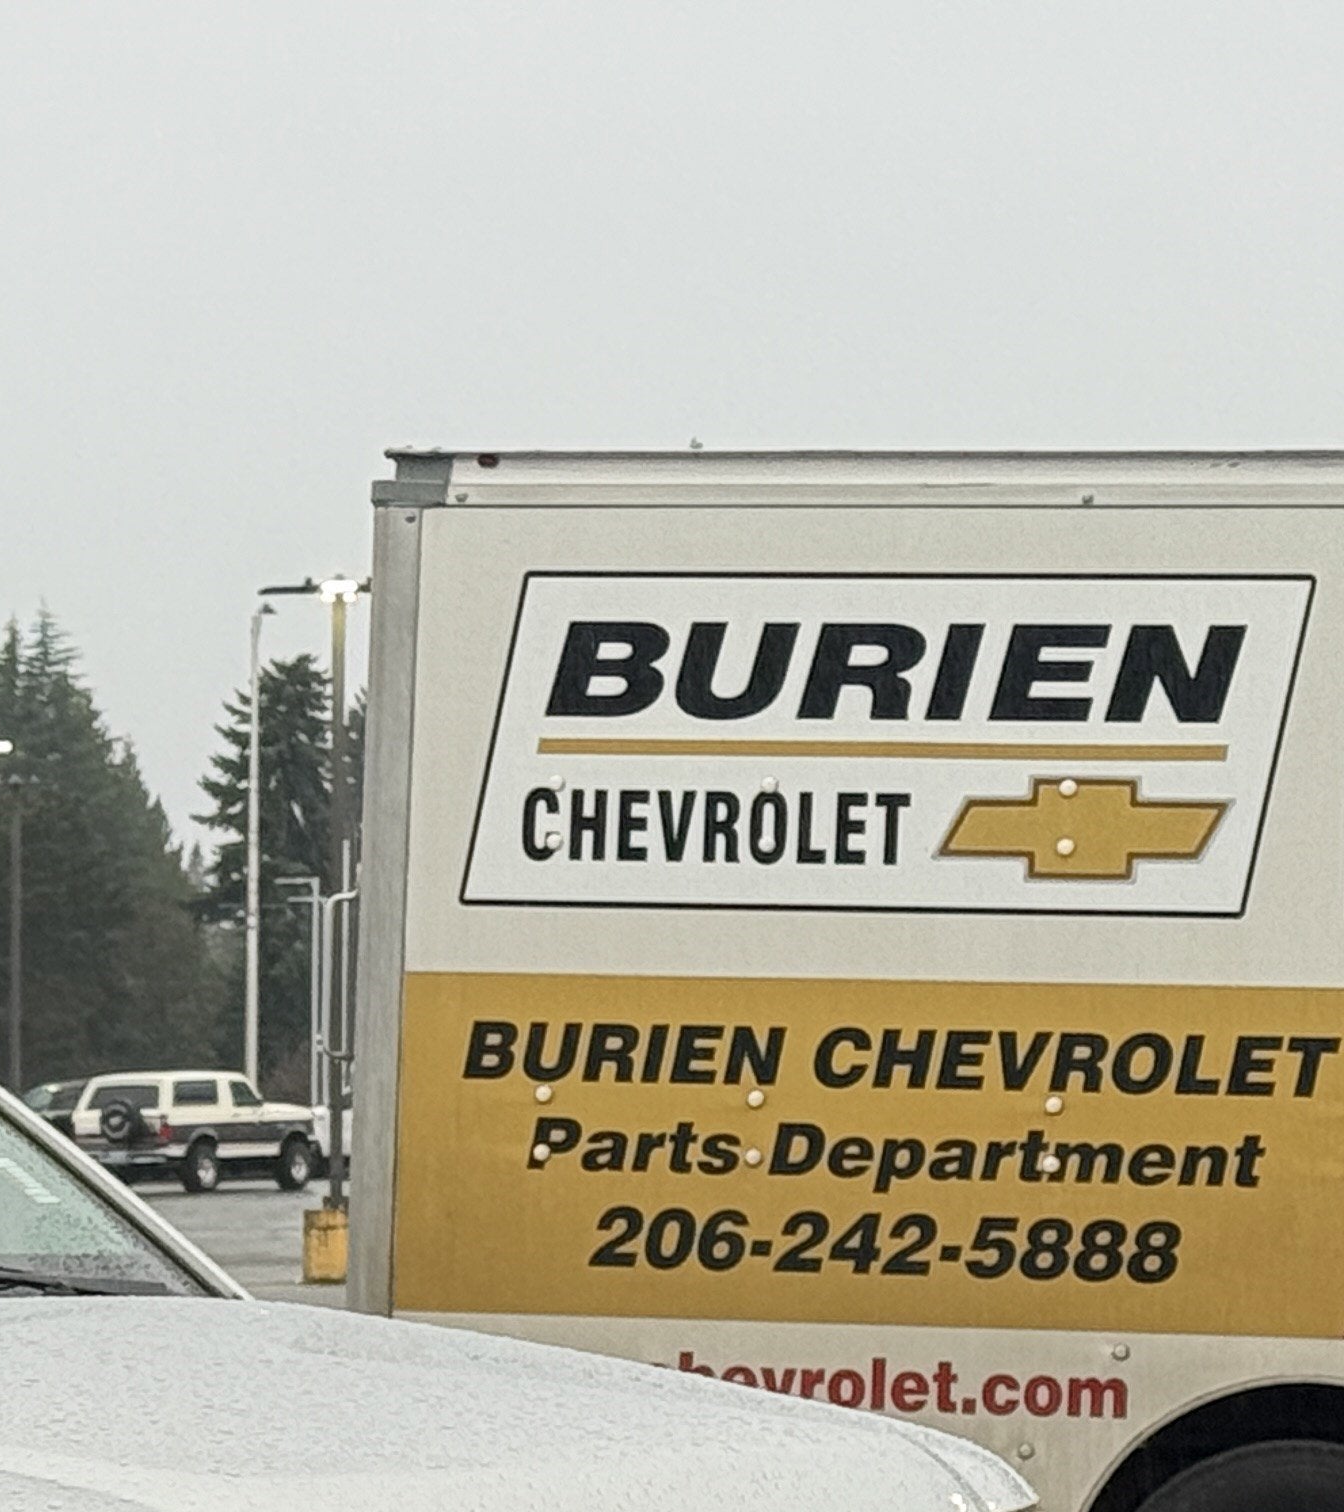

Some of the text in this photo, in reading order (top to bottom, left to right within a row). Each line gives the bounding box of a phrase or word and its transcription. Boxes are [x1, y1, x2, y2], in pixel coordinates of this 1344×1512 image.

[544, 621, 1247, 723] BURIEN
[521, 786, 912, 865] CHEVROLET
[462, 1020, 1341, 1097] BURIEN CHEVROLET
[527, 1117, 1266, 1193] Parts Department
[588, 1206, 1182, 1284] 206-242-5888
